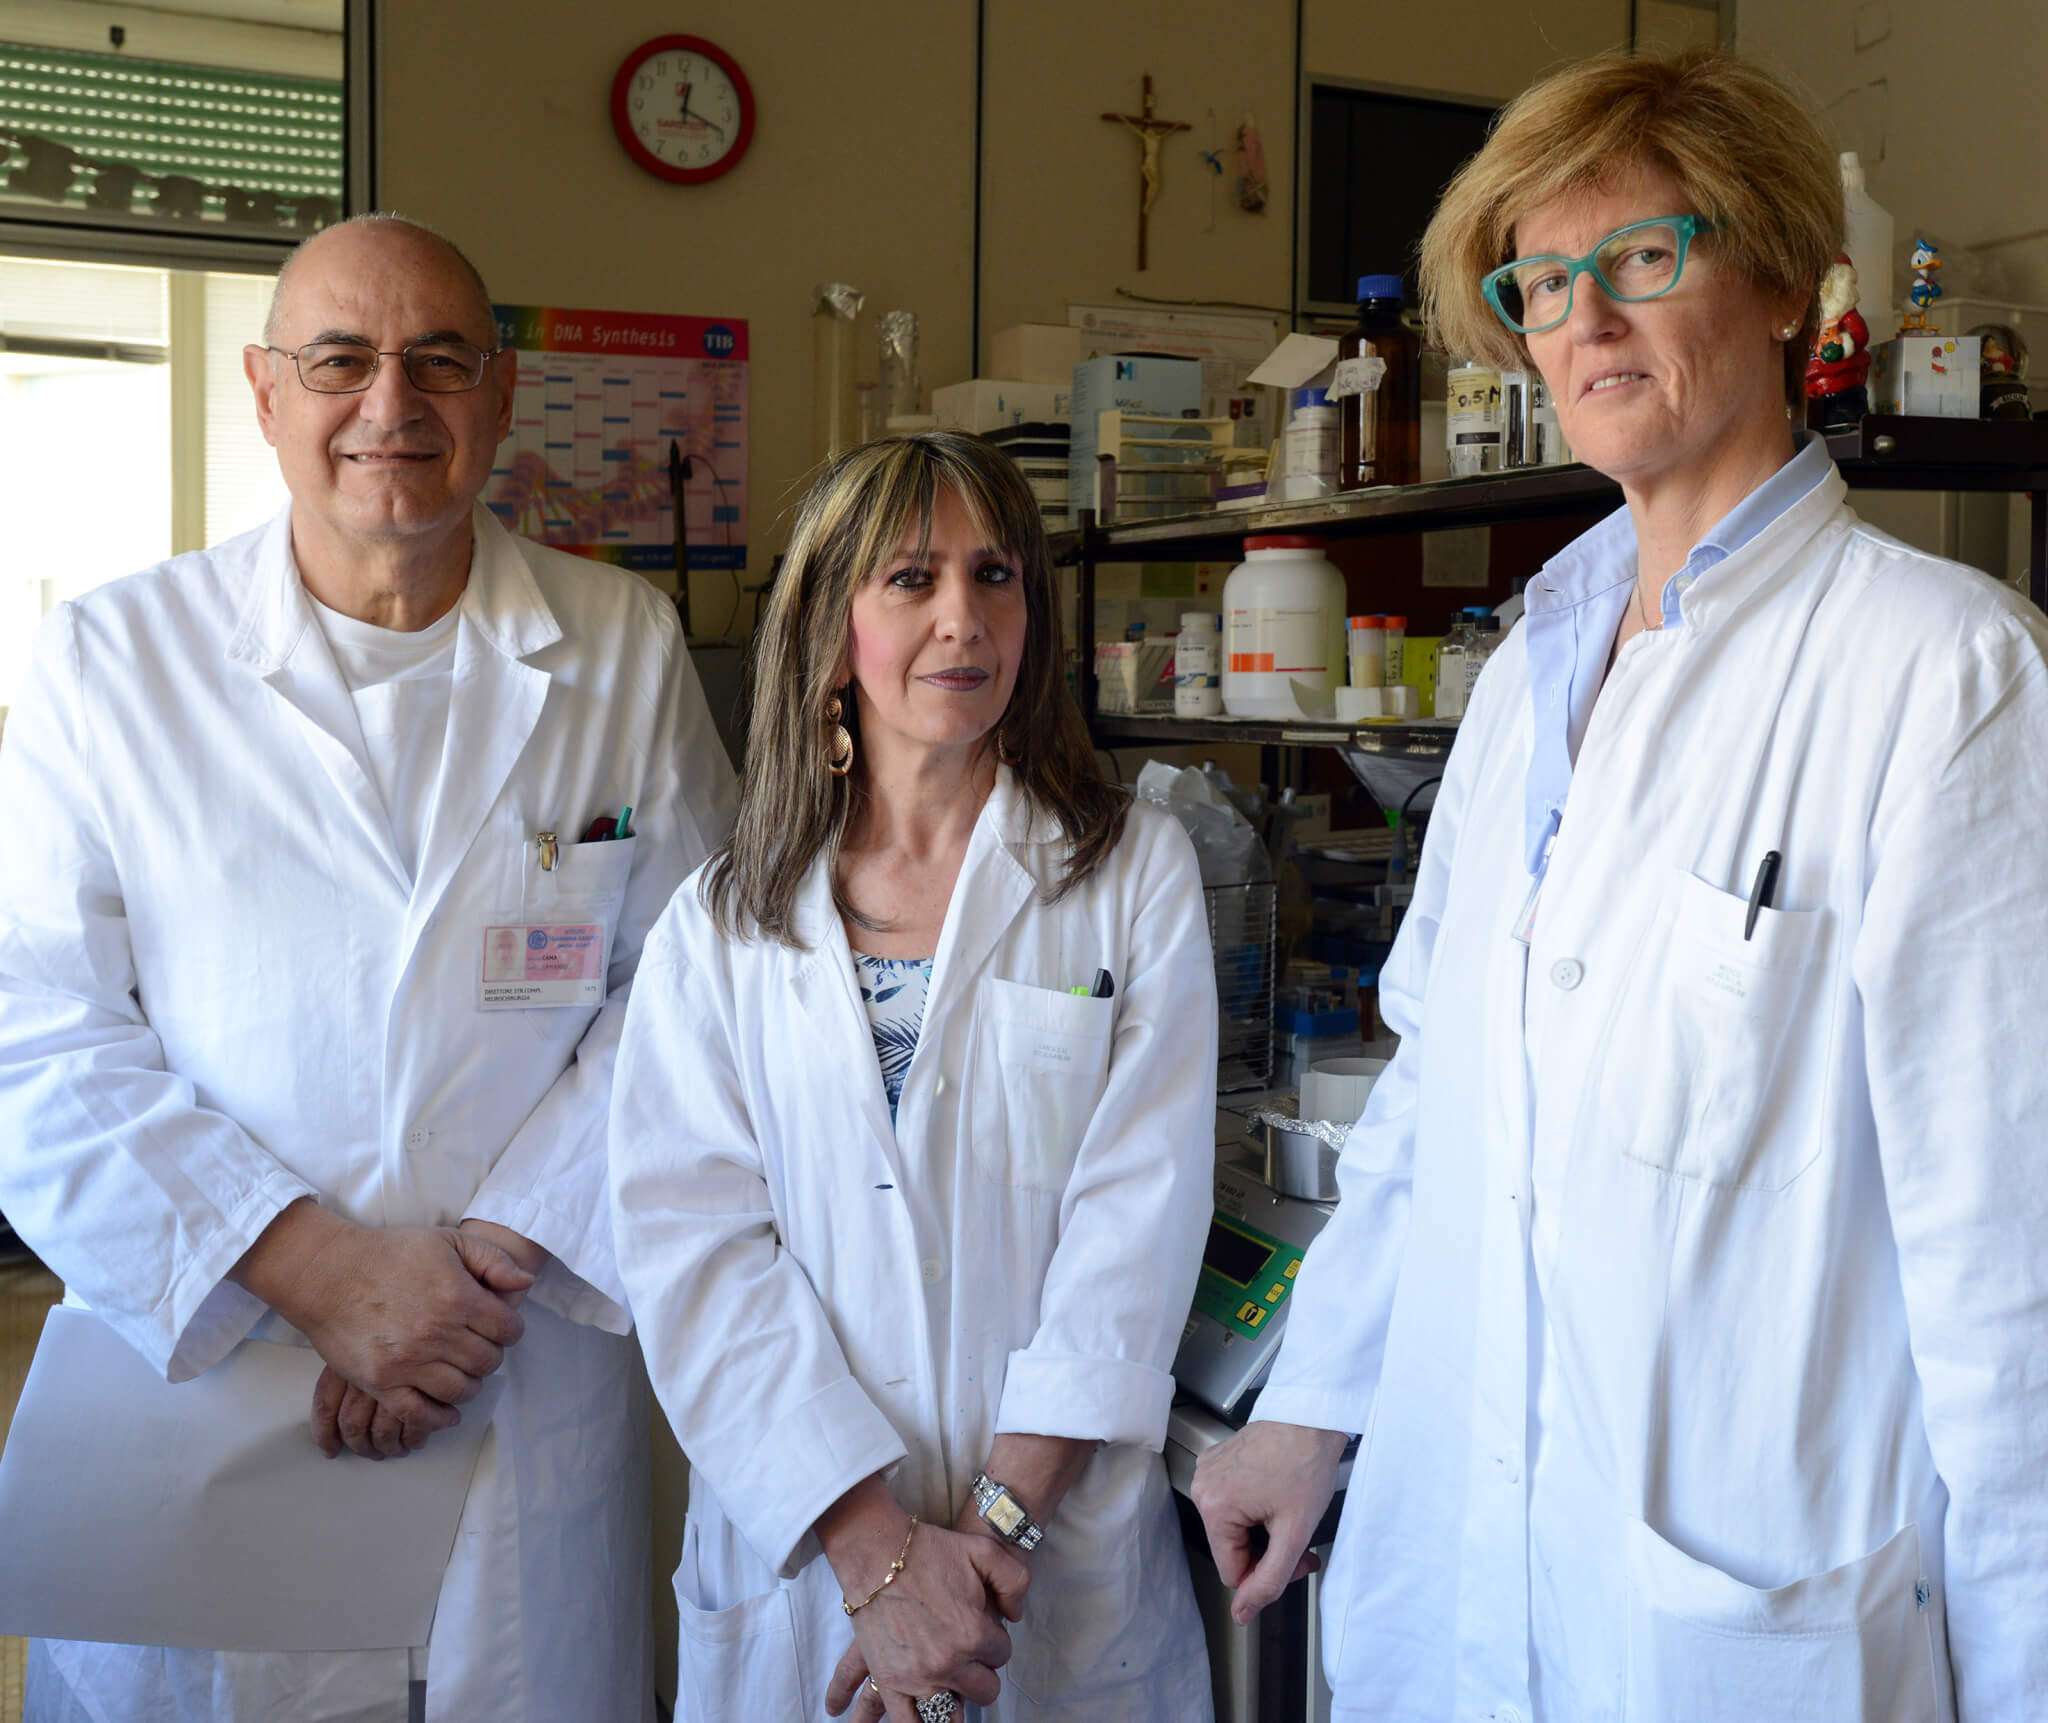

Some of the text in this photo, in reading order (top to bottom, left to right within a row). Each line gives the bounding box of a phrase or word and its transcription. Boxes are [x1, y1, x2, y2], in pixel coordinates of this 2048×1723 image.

[526, 323, 545, 338] in
[554, 324, 583, 343] DNA
[592, 326, 676, 348] Synthesis
[704, 334, 734, 349] TIB
